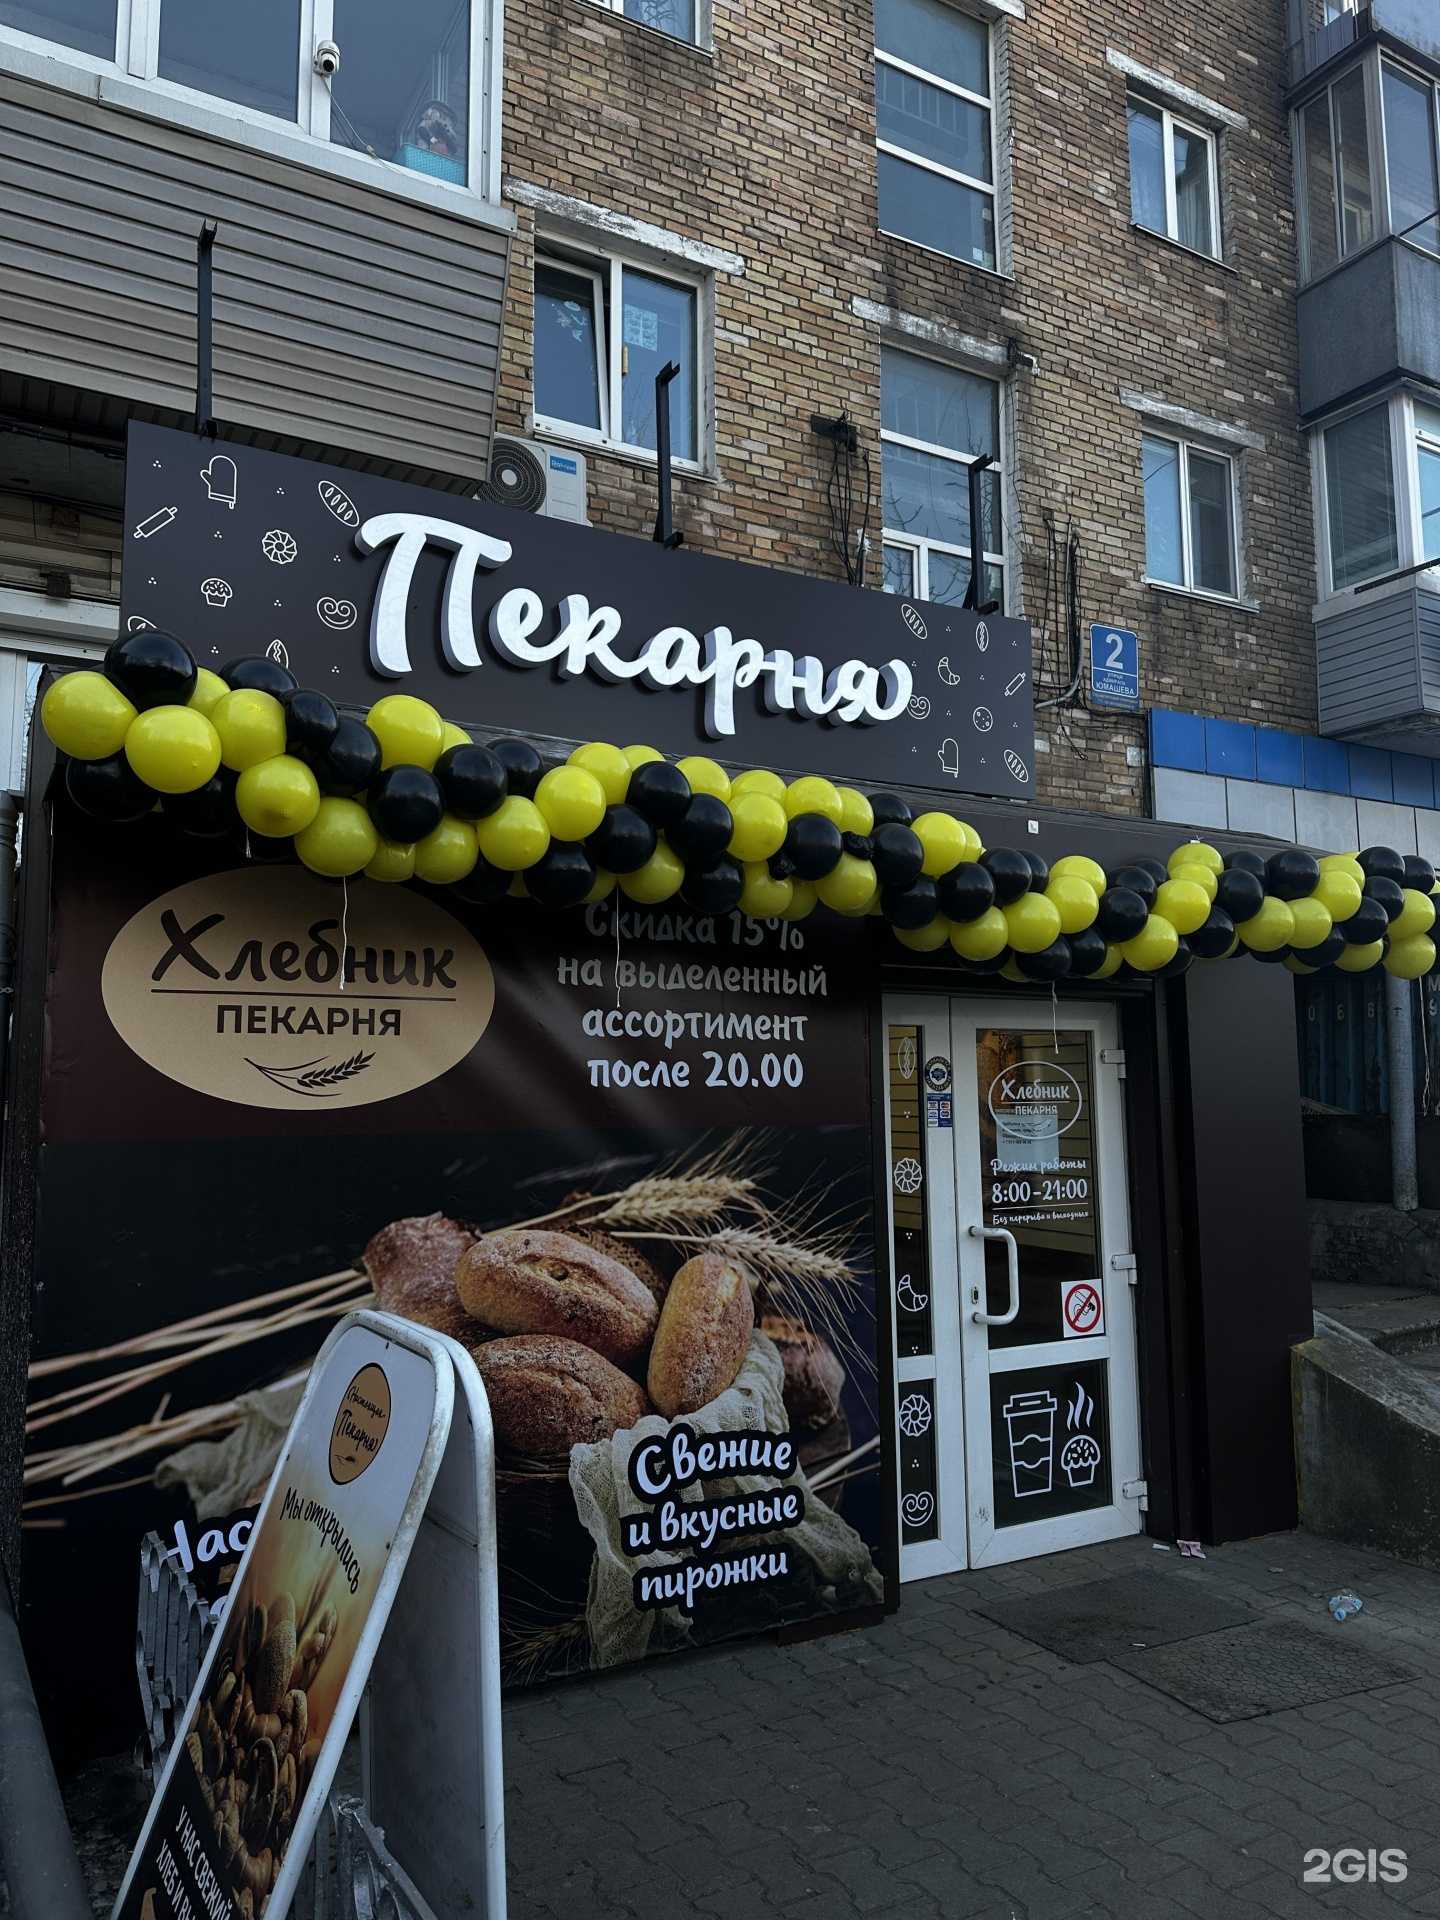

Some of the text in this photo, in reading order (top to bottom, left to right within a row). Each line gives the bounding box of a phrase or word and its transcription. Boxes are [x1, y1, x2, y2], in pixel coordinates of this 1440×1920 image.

[354, 512, 913, 740] Пекарня
[1105, 633, 1123, 670] 2
[1096, 681, 1135, 695] ЮМАШЕВА
[585, 901, 805, 951] Скидка 15%
[151, 909, 457, 989] Хлебник
[557, 957, 828, 996] на выделенный
[216, 1005, 401, 1036] ПЕКАРНЯ
[582, 1008, 808, 1049] ассортимент
[587, 1051, 803, 1088] после 20.00
[1001, 1078, 1071, 1101] Хлебник
[1015, 1105, 1058, 1116] ПЕКАРНЯ
[990, 1156, 1087, 1176] Режим работы
[992, 1214, 1008, 1226] Без
[636, 1432, 792, 1495] Свежие
[280, 1487, 361, 1595] Мы открылись
[629, 1494, 798, 1549] и вкусные
[641, 1552, 789, 1609] пирожки
[175, 1805, 188, 1832] У
[180, 1817, 201, 1868] НАС
[156, 1838, 179, 1896] ХЛЕБ
